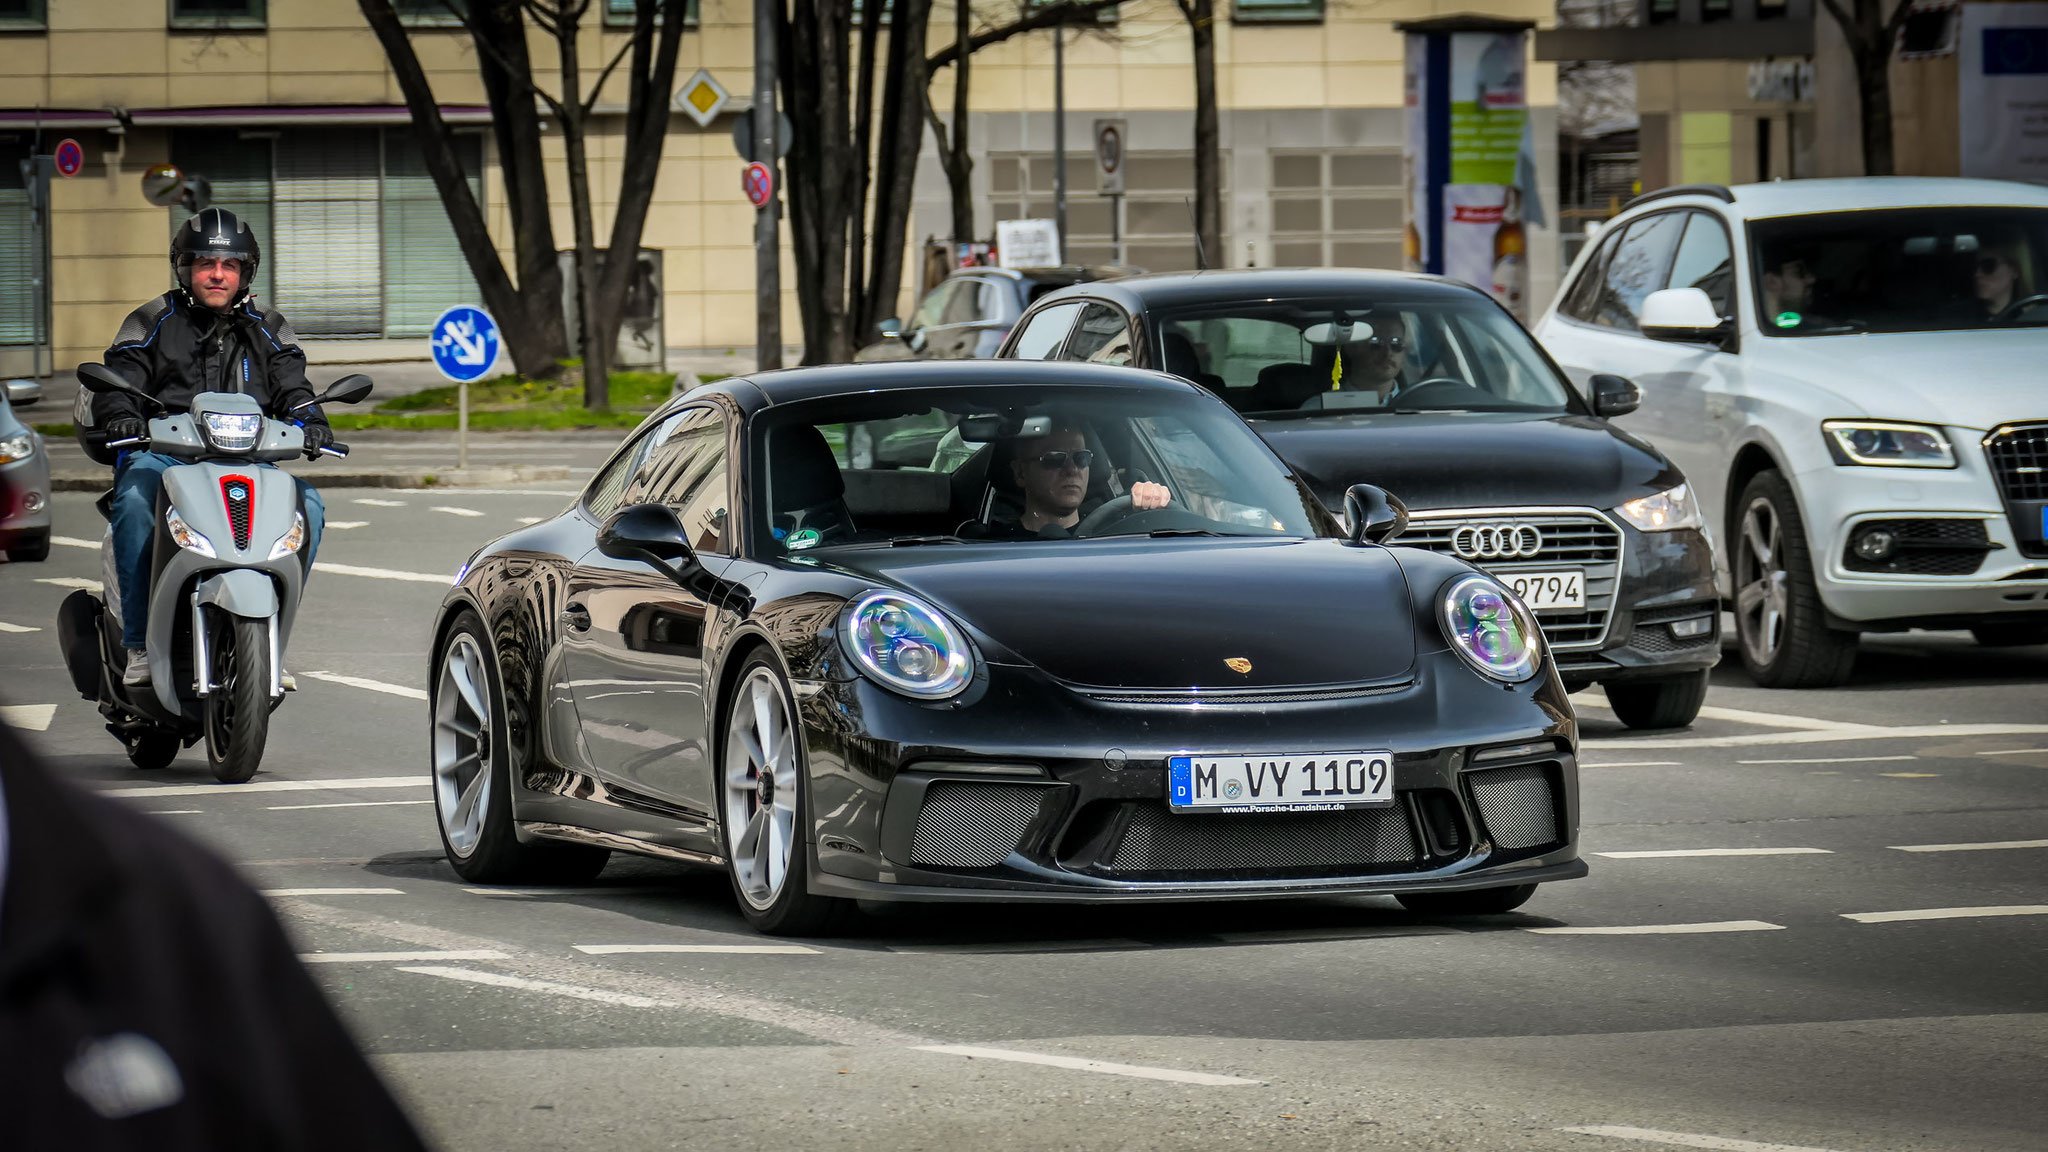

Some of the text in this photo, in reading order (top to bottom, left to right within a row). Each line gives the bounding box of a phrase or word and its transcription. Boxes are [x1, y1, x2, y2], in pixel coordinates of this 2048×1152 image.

[1513, 576, 1578, 603] 9794
[1195, 759, 1387, 799] M VY 1109
[1177, 786, 1186, 797] D
[1221, 804, 1346, 814] www.Porsche-Landshut.de
